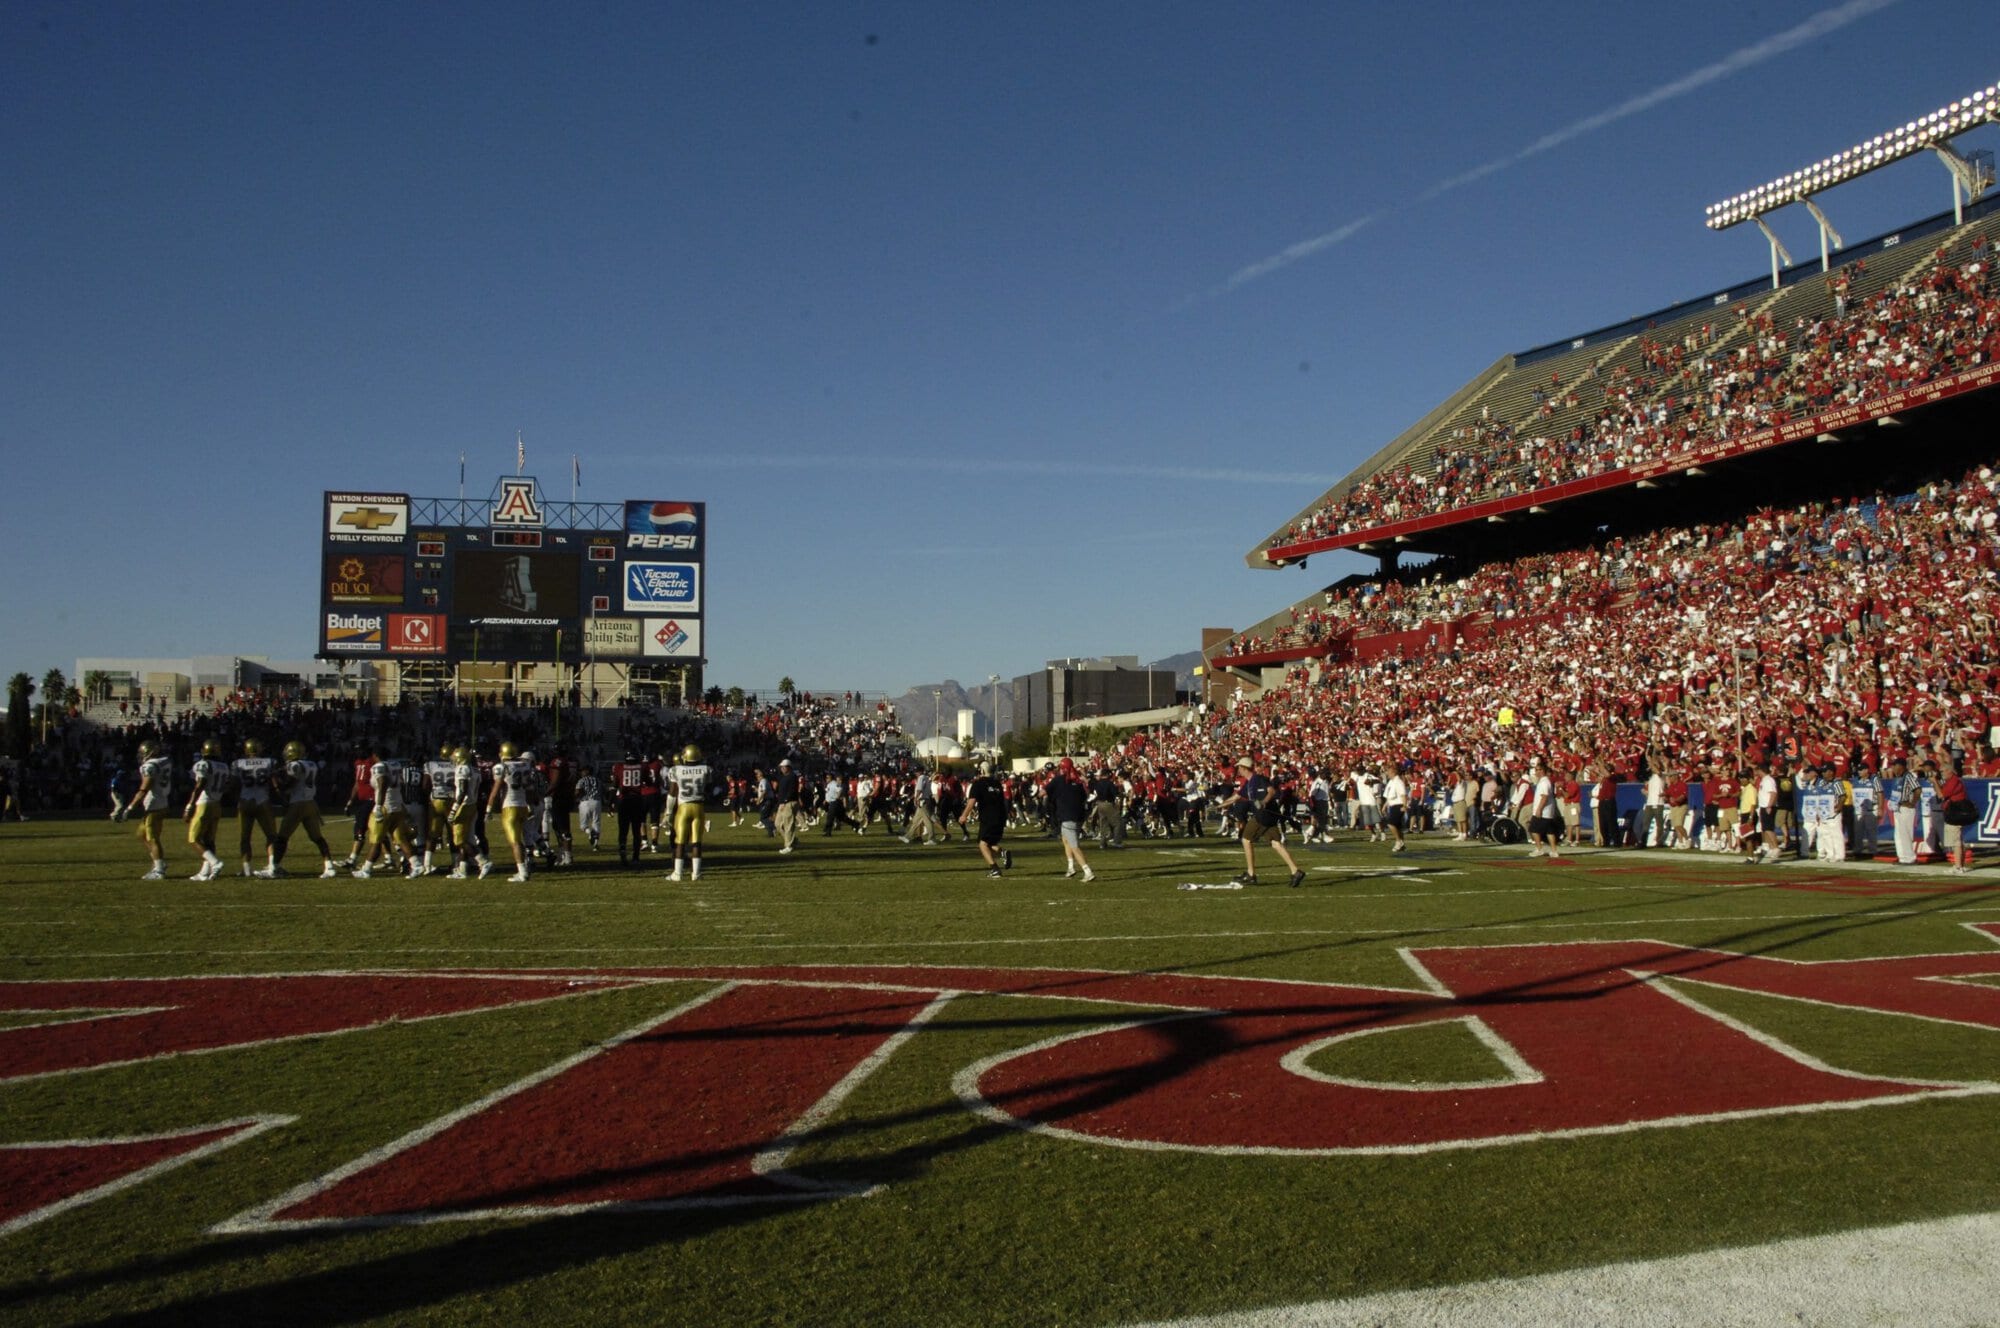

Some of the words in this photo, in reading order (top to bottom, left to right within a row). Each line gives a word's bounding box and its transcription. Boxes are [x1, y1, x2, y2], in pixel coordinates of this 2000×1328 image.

[1909, 384, 1934, 398] COPPER
[1935, 378, 1955, 390] BOWL
[1864, 399, 1886, 411] ALOHA
[1886, 393, 1906, 405] BOWL
[1820, 412, 1841, 424] FIESTA
[1842, 406, 1860, 418] BOWL
[1780, 425, 1794, 434] SUN
[1795, 420, 1815, 431] BOWL
[1701, 446, 1719, 456] SALAD
[332, 495, 362, 503] WATSON
[362, 496, 406, 504] CHEVROLET
[491, 480, 543, 525] A
[362, 535, 404, 543] CHEVROLET
[627, 534, 697, 550] PEPSI
[645, 568, 679, 580] Tucson
[331, 582, 349, 594] DEL
[353, 582, 372, 594] SOL
[648, 578, 689, 588] Electric
[652, 588, 688, 597] Power
[327, 614, 382, 632] Budget
[482, 617, 560, 625] ARIZONAATHLETICS.COM
[590, 619, 632, 630] Arizona
[616, 632, 639, 644] Star
[1784, 738, 1798, 756] 3
[622, 770, 641, 787] 88
[681, 778, 705, 797] 51
